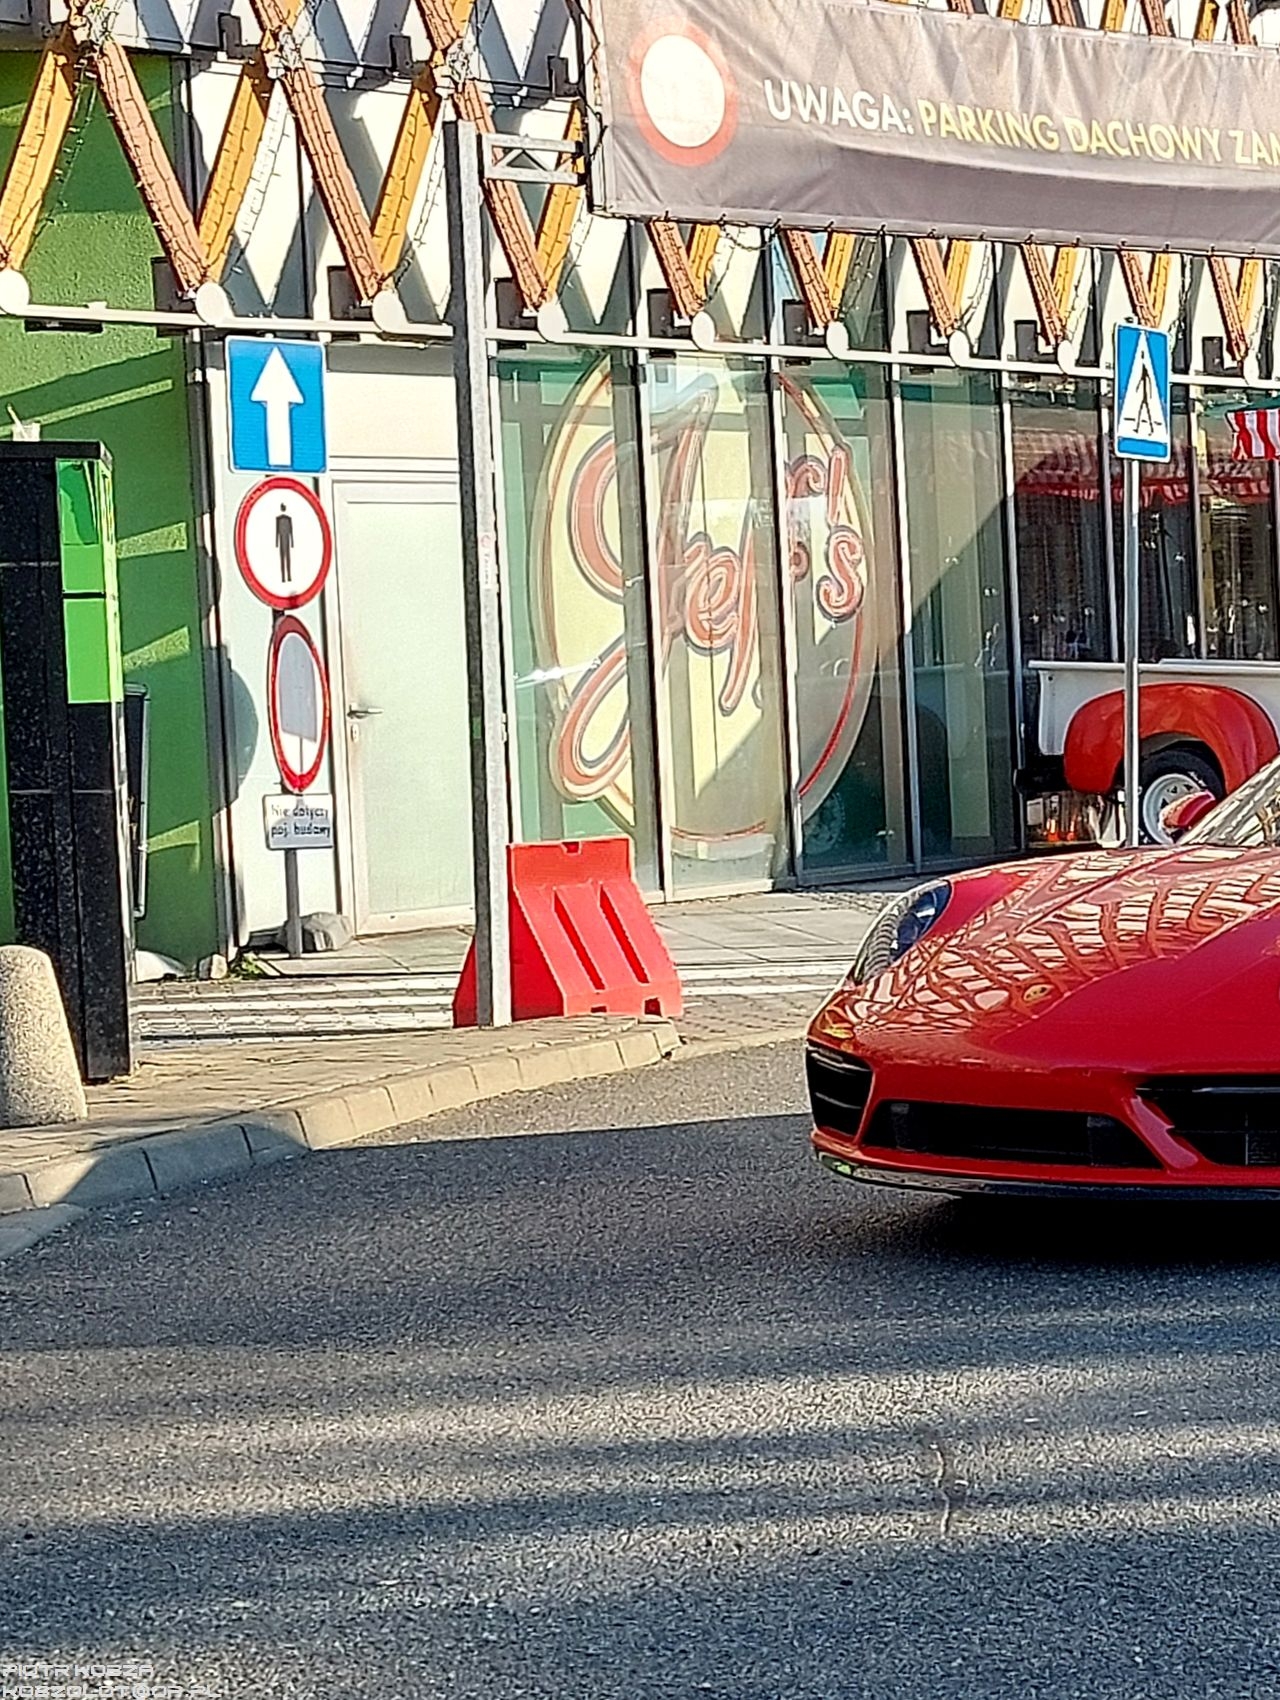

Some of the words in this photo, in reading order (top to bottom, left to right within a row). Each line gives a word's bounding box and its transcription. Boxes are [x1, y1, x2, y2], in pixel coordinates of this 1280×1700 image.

[763, 79, 915, 135] UWAGA:
[916, 99, 1060, 154] PARKING
[1064, 117, 1222, 166] DACHOWY
